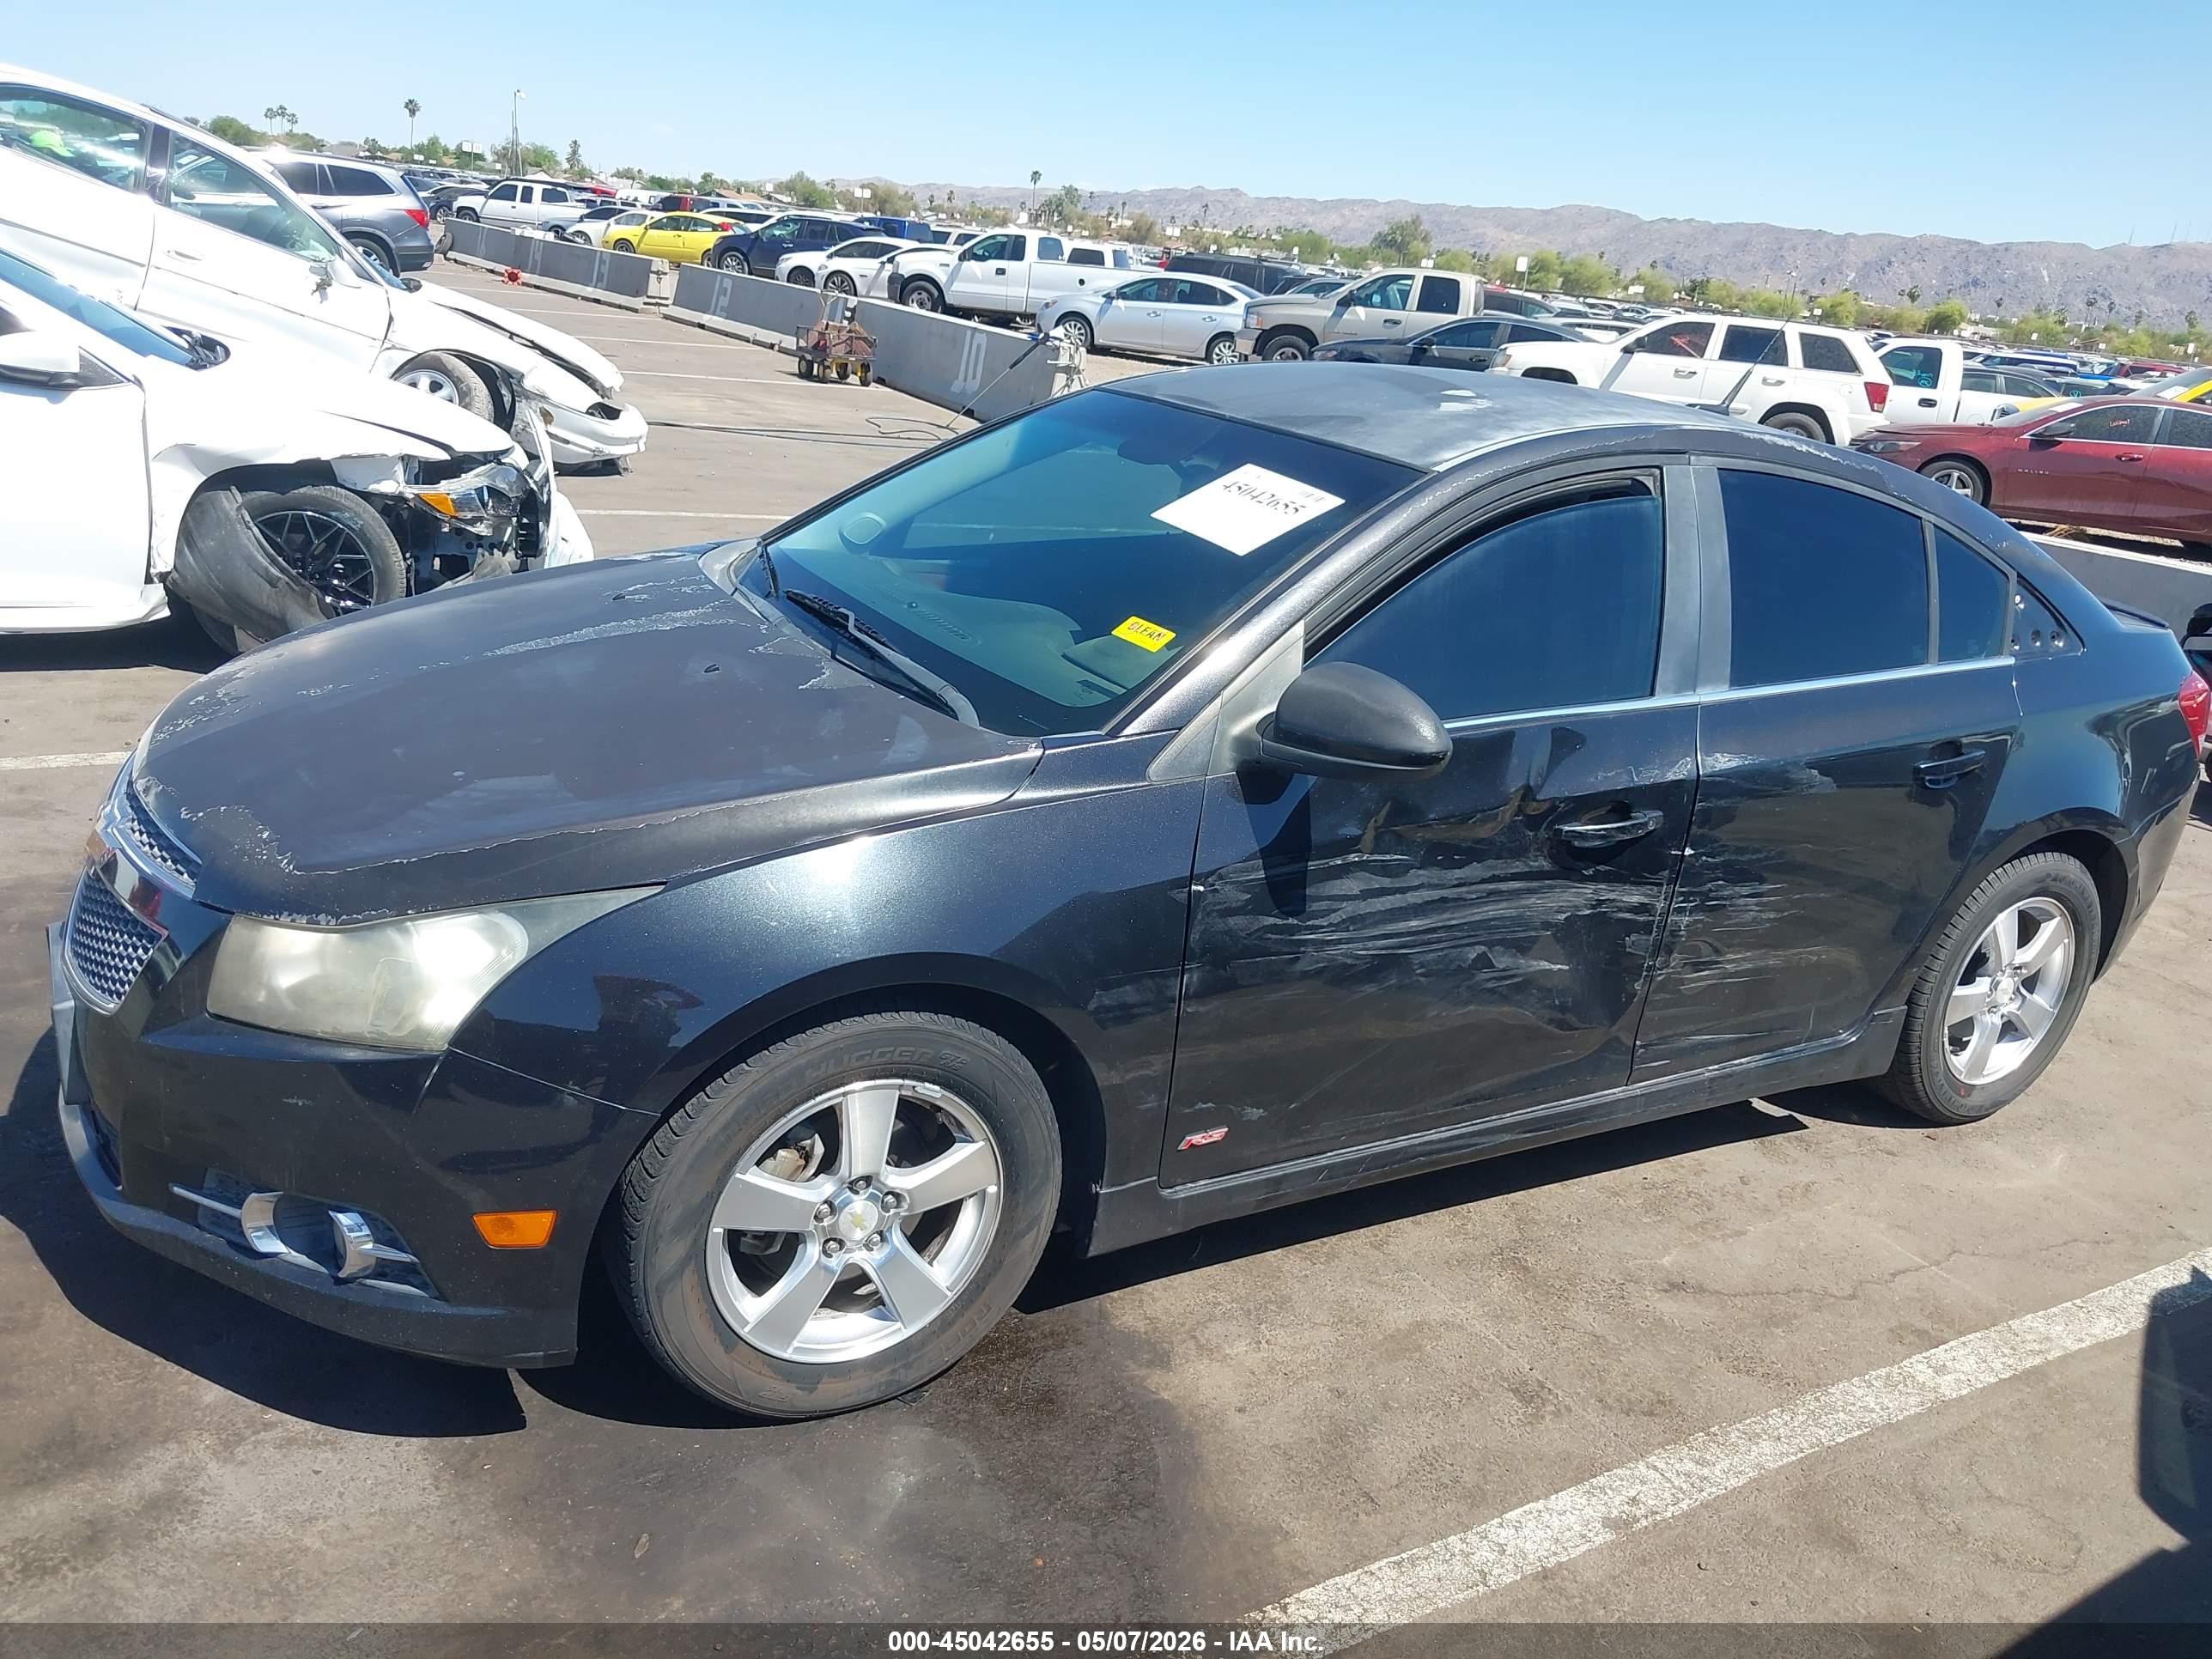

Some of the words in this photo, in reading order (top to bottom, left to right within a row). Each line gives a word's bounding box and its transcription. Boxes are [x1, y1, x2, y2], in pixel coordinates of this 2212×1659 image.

[592, 250, 611, 289] 13
[708, 275, 732, 318] 12
[951, 330, 988, 393] 10
[1222, 481, 1306, 515] 45042655
[1177, 1126, 1229, 1150] RS
